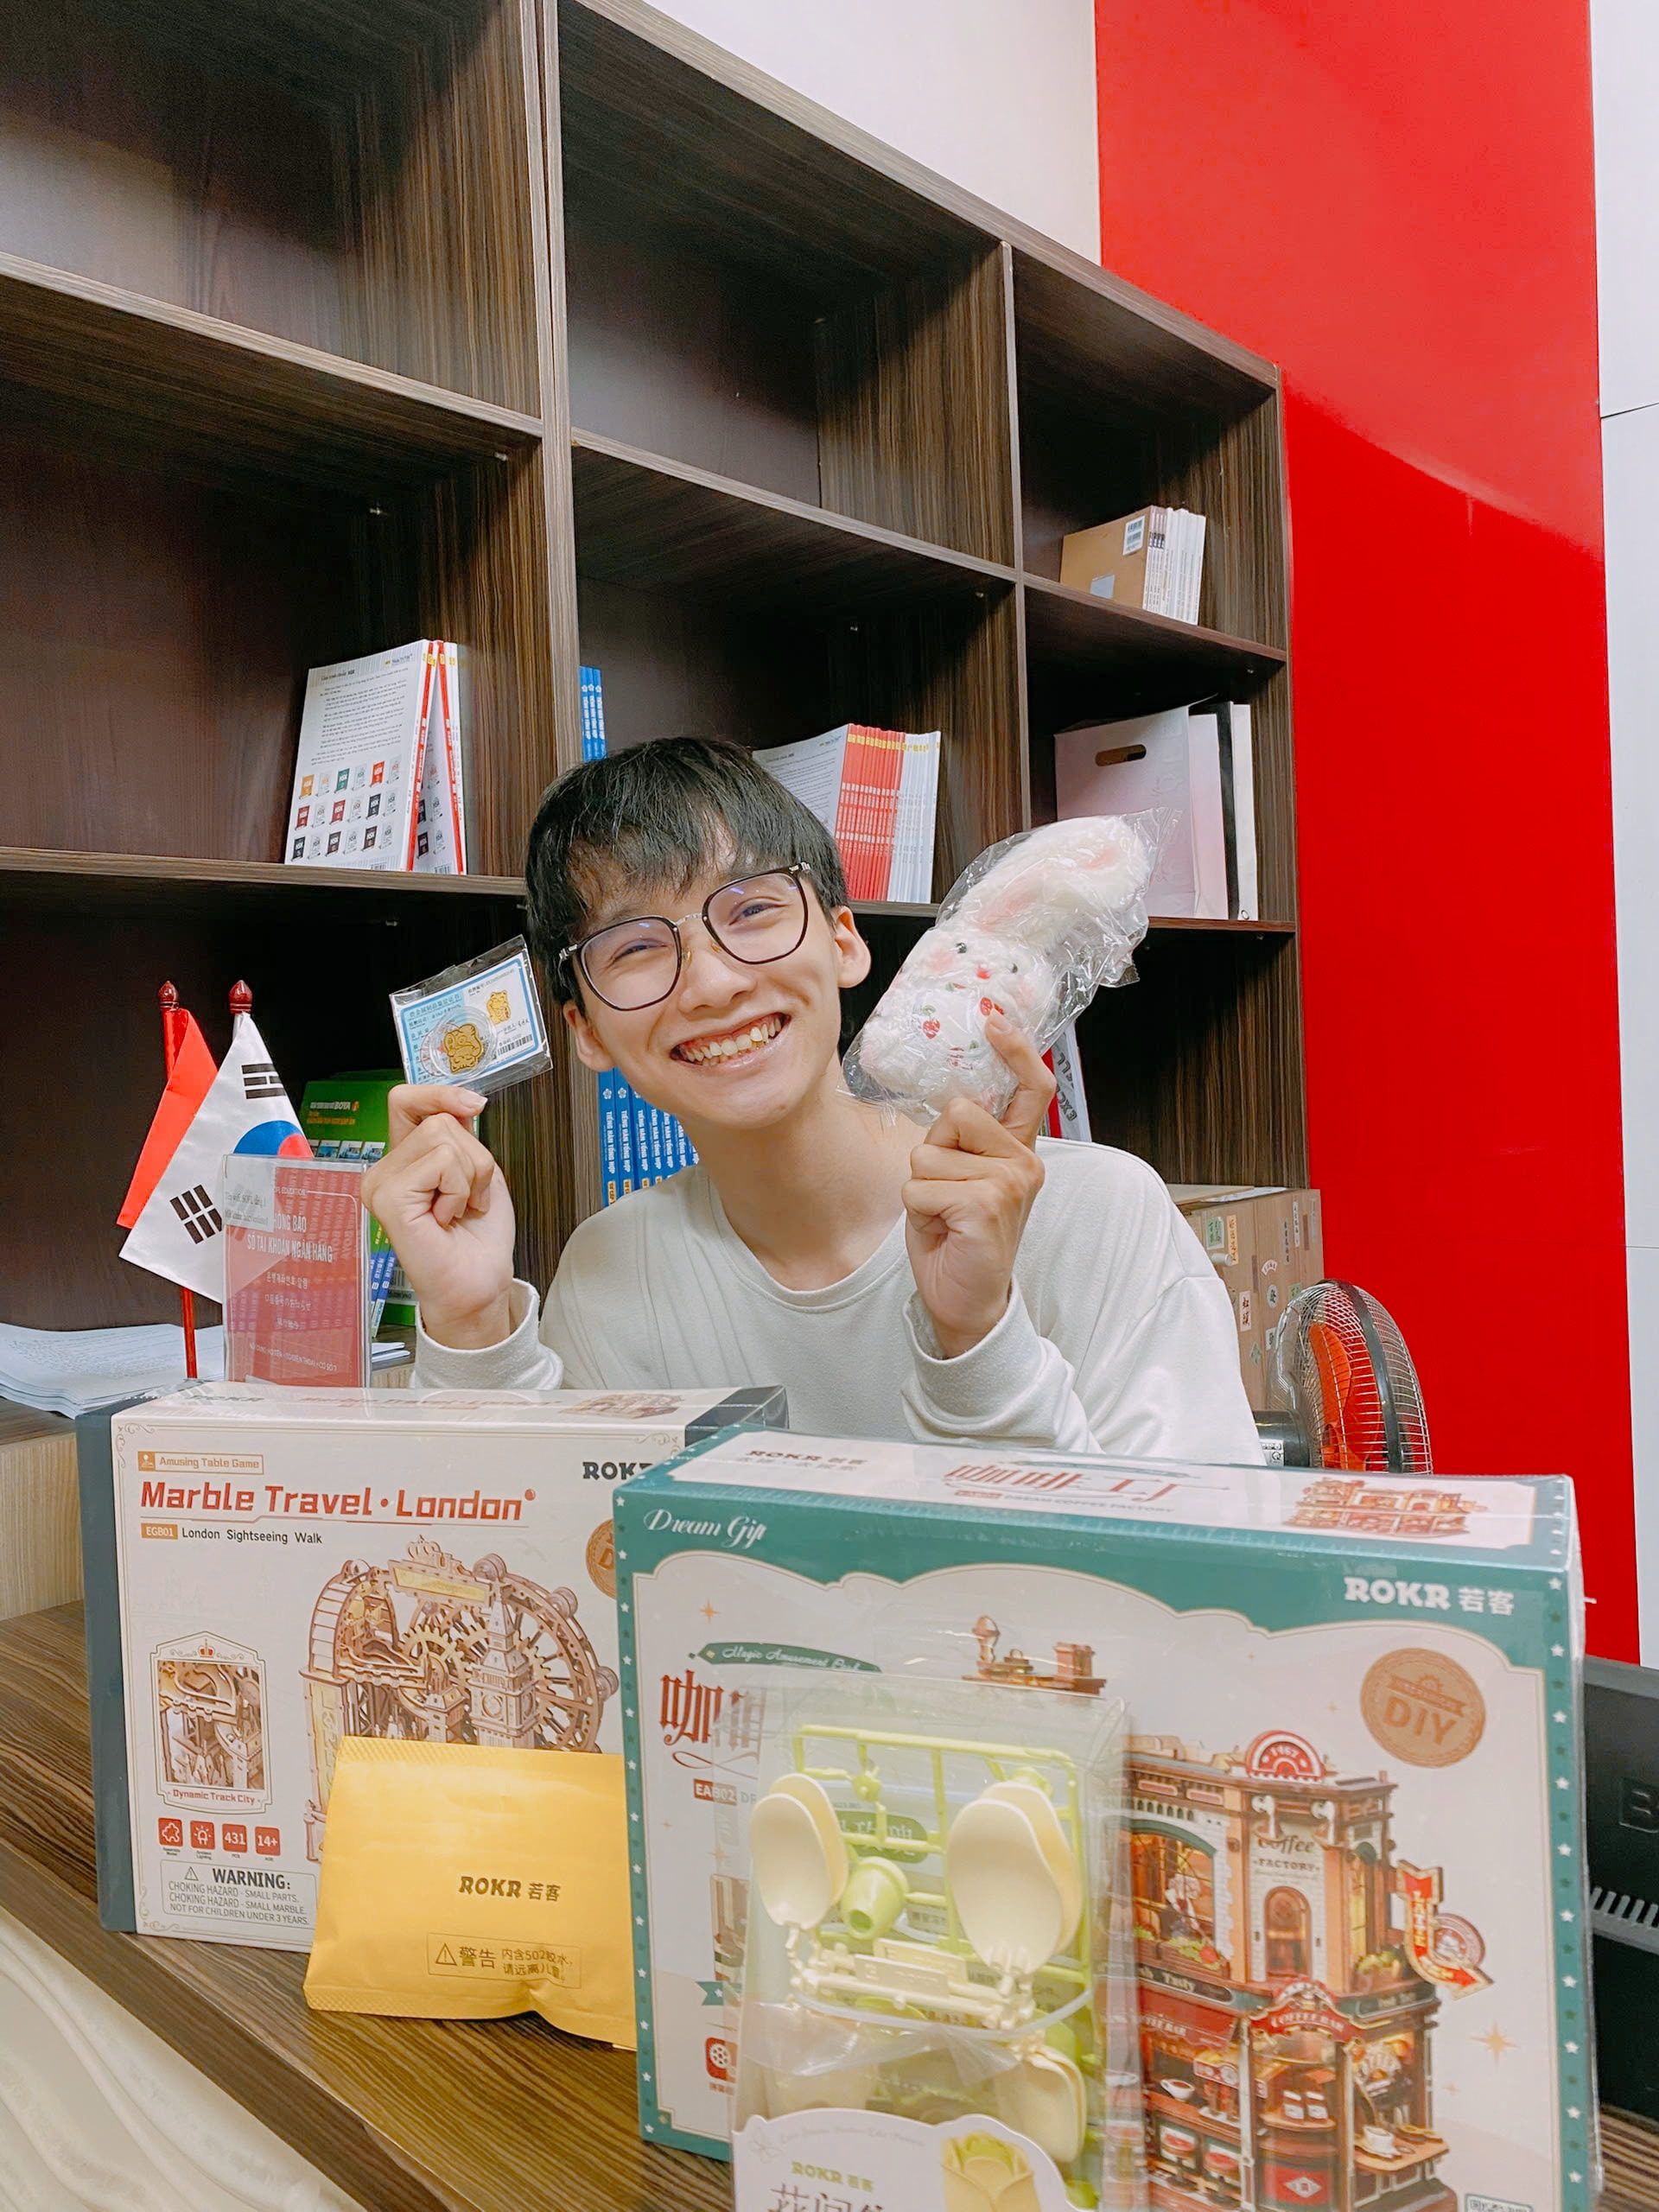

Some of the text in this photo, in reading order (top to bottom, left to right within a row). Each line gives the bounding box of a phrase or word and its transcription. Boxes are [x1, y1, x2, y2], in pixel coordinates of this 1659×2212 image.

[159, 1457, 259, 1469] Amusing Table Game
[747, 1450, 822, 1462] ROKR
[582, 1462, 653, 1481] ROK
[141, 1481, 522, 1521] Marble Travel London
[643, 1509, 721, 1536] Dream
[145, 1526, 323, 1545] EGB01 London Sightseeing Walk
[1344, 1576, 1515, 1616] ROKR 若客
[766, 1649, 830, 1668] Amusement
[1383, 1695, 1458, 1746] DIY
[173, 1789, 255, 1806] Dynamic Track City
[696, 1784, 736, 1802] EAB02
[225, 1832, 245, 1846] 431
[257, 1834, 278, 1847] 14+
[1258, 1834, 1314, 1855] Coffee
[1259, 1859, 1315, 1872] FACTORY
[213, 1867, 290, 1890] WARNING:
[459, 1876, 561, 1902] ROKR 若客
[168, 1880, 205, 1894] CHOKING
[207, 1885, 238, 1897] HAZARD
[245, 1889, 270, 1901] SMALL
[273, 1892, 299, 1903] PARTS.
[169, 1892, 207, 1904] CHOKING
[207, 1896, 239, 1908] HAZARD
[245, 1899, 271, 1911] SMALL
[273, 1903, 308, 1915] MARBLE.
[170, 1903, 187, 1913] NOT
[188, 1905, 204, 1915] FOR
[206, 1907, 245, 1918] CHILDREN
[246, 1911, 275, 1922] UNDER
[282, 1915, 308, 1925] YEARS.
[459, 1946, 496, 1968] 警告
[791, 2161, 843, 2184] ROKR
